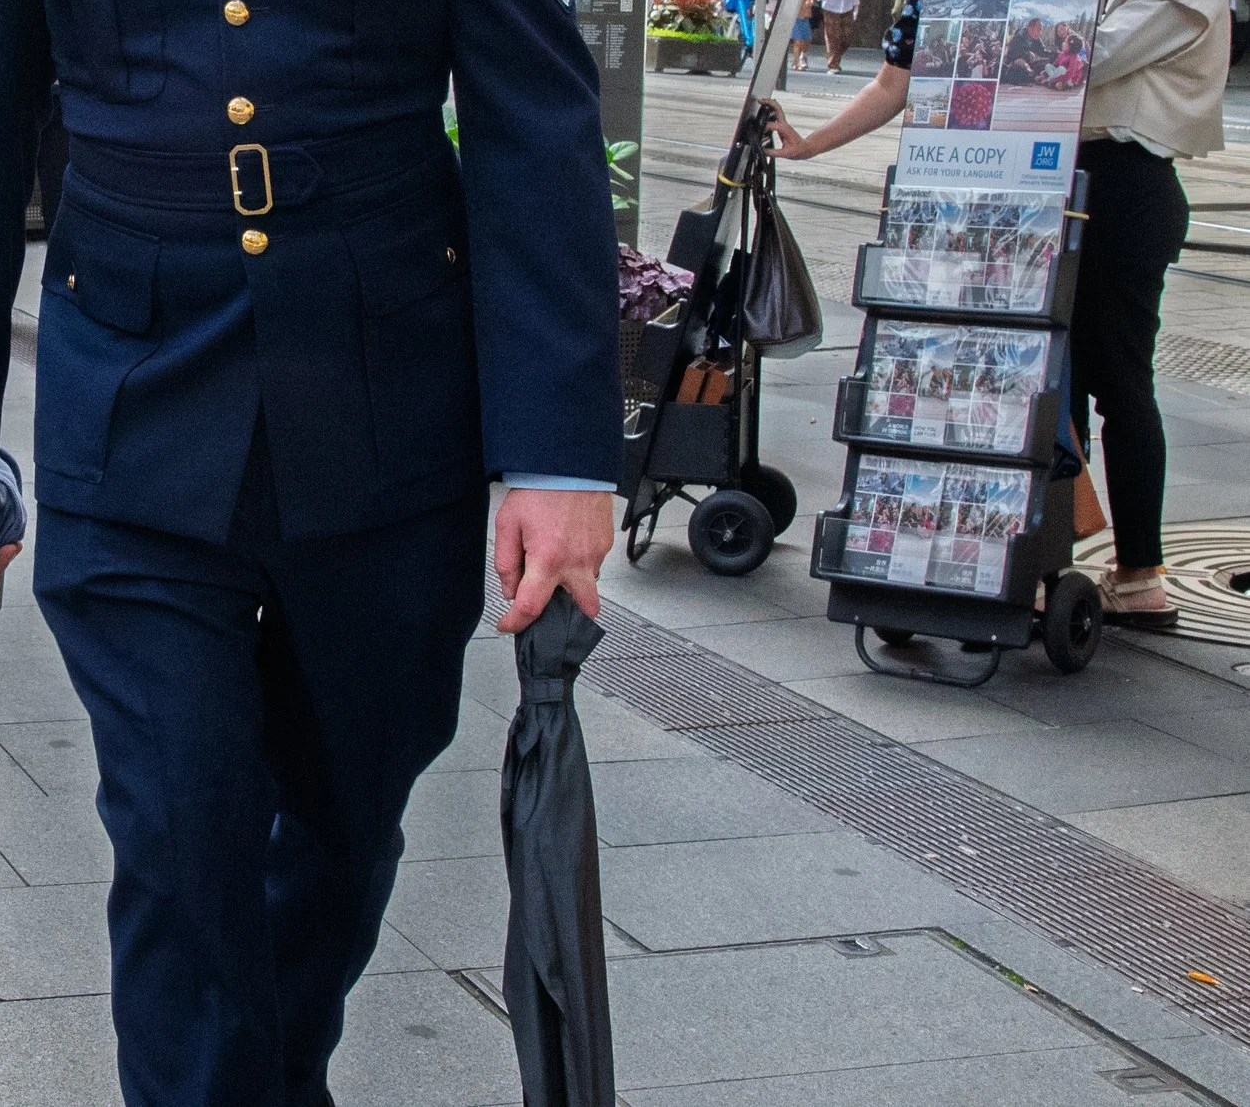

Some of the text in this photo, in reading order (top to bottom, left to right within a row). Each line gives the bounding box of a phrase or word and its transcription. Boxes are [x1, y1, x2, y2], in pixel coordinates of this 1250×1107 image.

[908, 145, 1007, 165] TAKE A COPY
[1037, 146, 1055, 157] JW
[906, 167, 1004, 180] ASK FOR YOUR LANGUAGE
